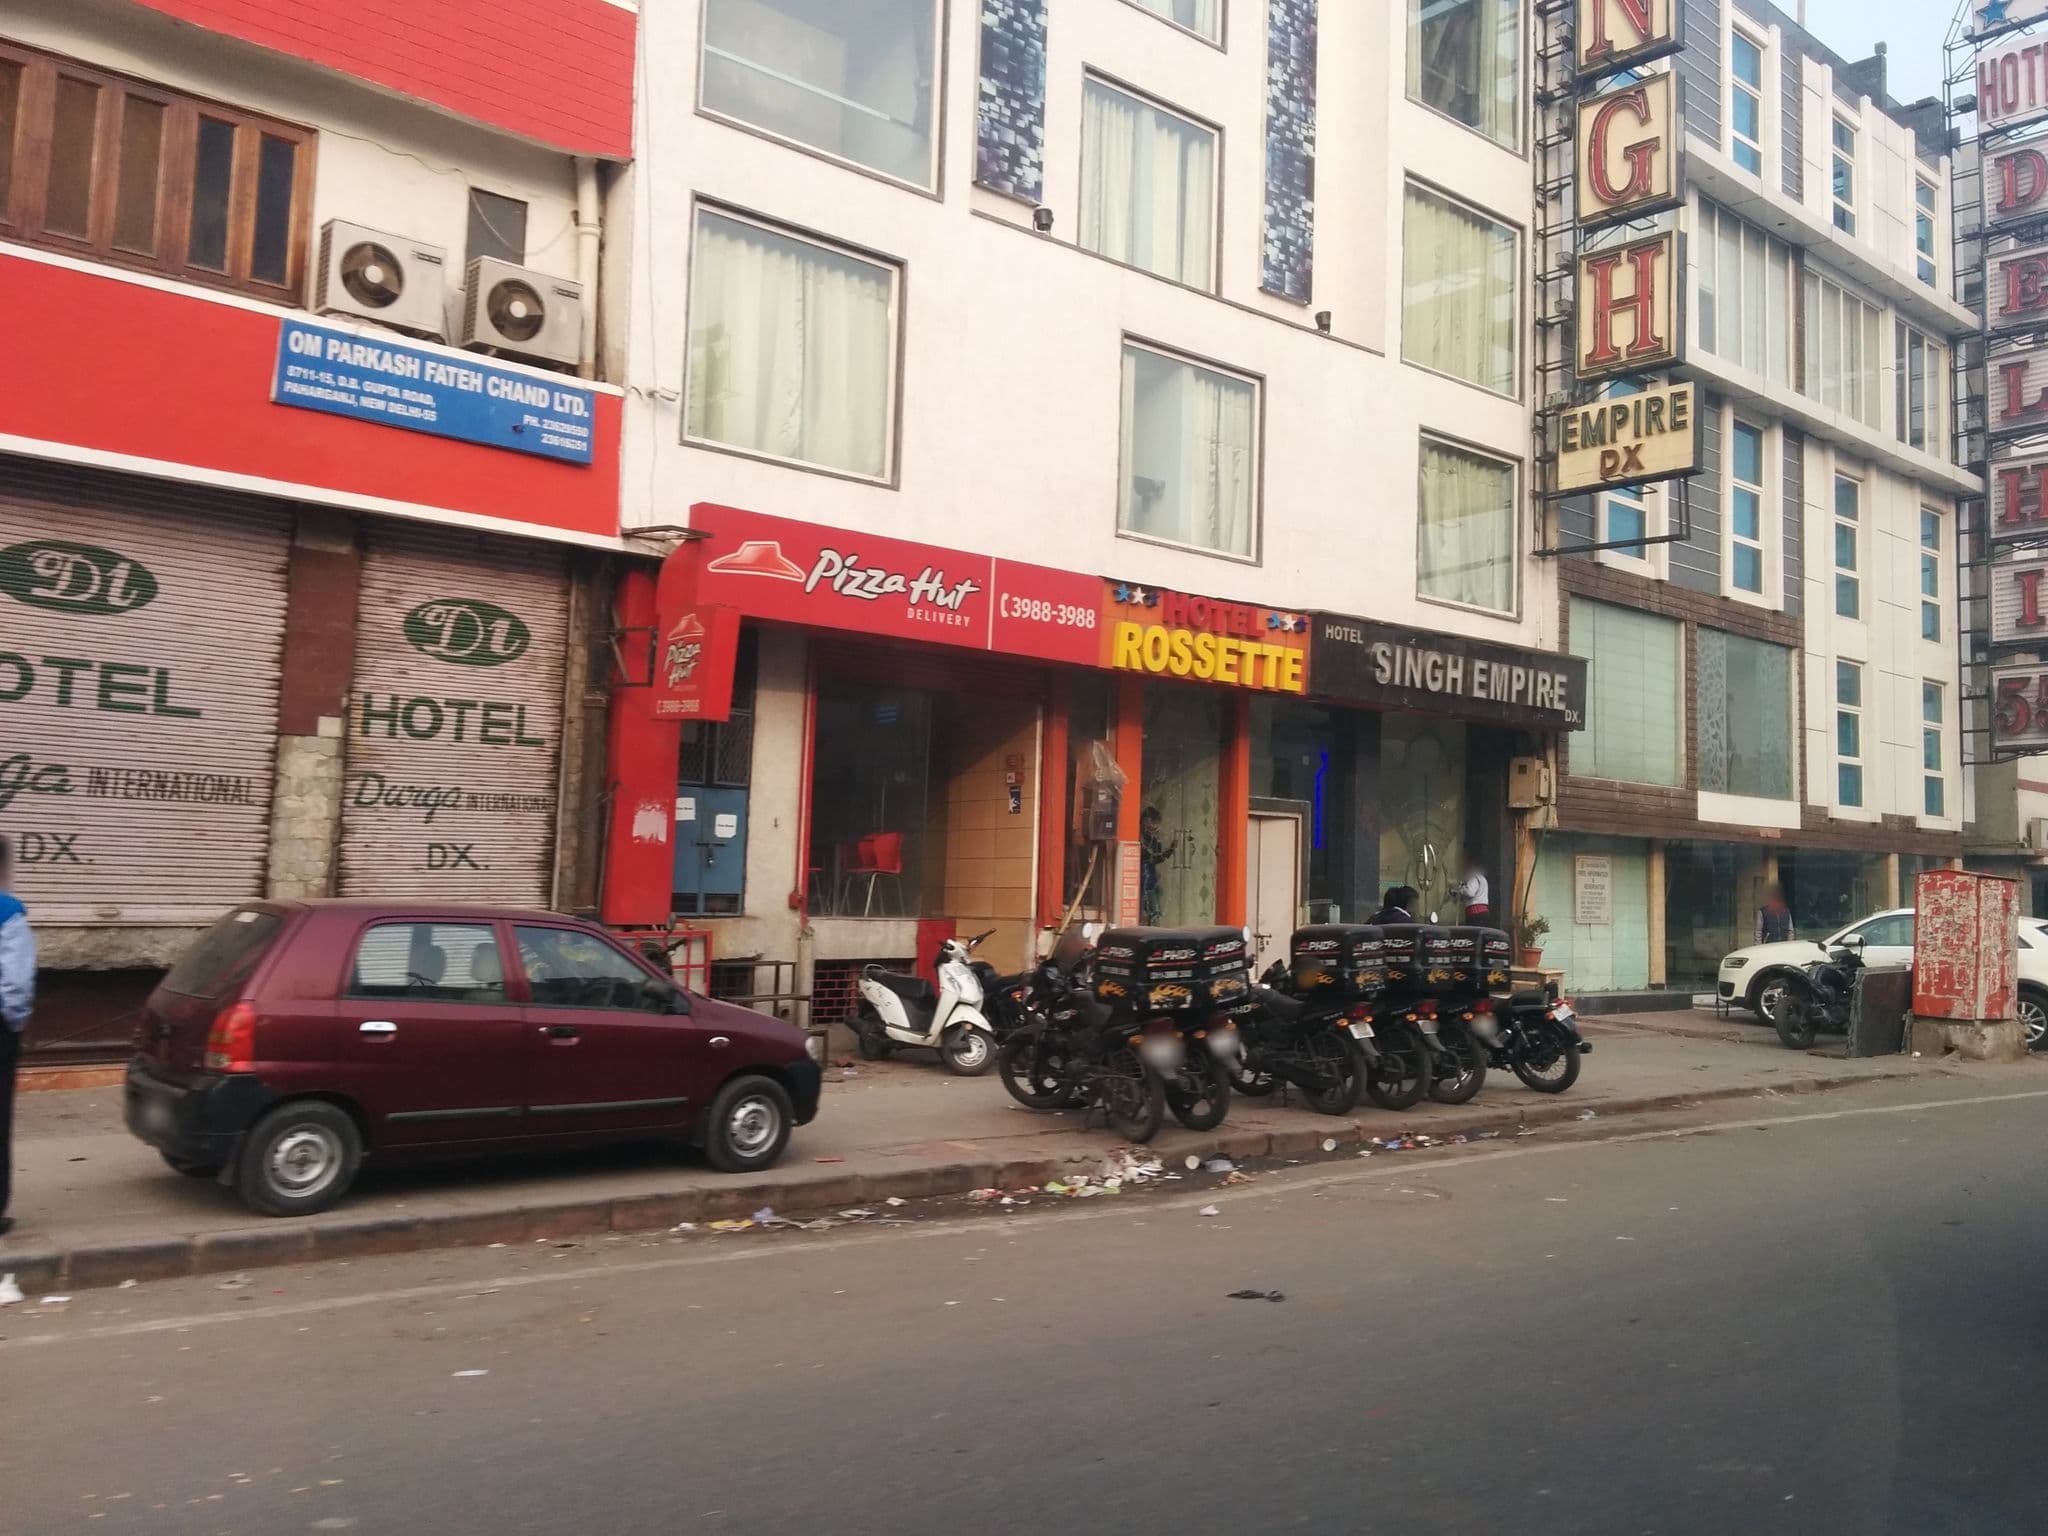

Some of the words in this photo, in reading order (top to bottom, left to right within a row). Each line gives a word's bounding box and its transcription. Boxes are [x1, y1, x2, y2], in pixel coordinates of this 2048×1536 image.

[1978, 41, 2048, 122] HOT
[288, 330, 322, 358] OM
[326, 338, 420, 379] PARKASH
[423, 360, 483, 393] FATEH
[487, 375, 550, 408] CHAND
[553, 391, 590, 418] LTD.
[359, 395, 387, 410] NEW
[1561, 390, 1689, 454] EMPIRE
[1599, 443, 1646, 479] DX
[805, 547, 908, 601] Pizza
[908, 566, 981, 611] Hut
[906, 607, 971, 628] DELIVERY
[1011, 595, 1097, 630] 3988-3988
[1162, 589, 1265, 639] HOTEL
[1325, 623, 1364, 645] HOTEL
[1112, 621, 1304, 693] ROSSETTE
[1373, 641, 1465, 696] SINGH
[1472, 658, 1569, 711] EMPIRE
[360, 692, 545, 747] HOTEL
[86, 766, 256, 806] INTERNATIONAL
[352, 771, 463, 825] Durga
